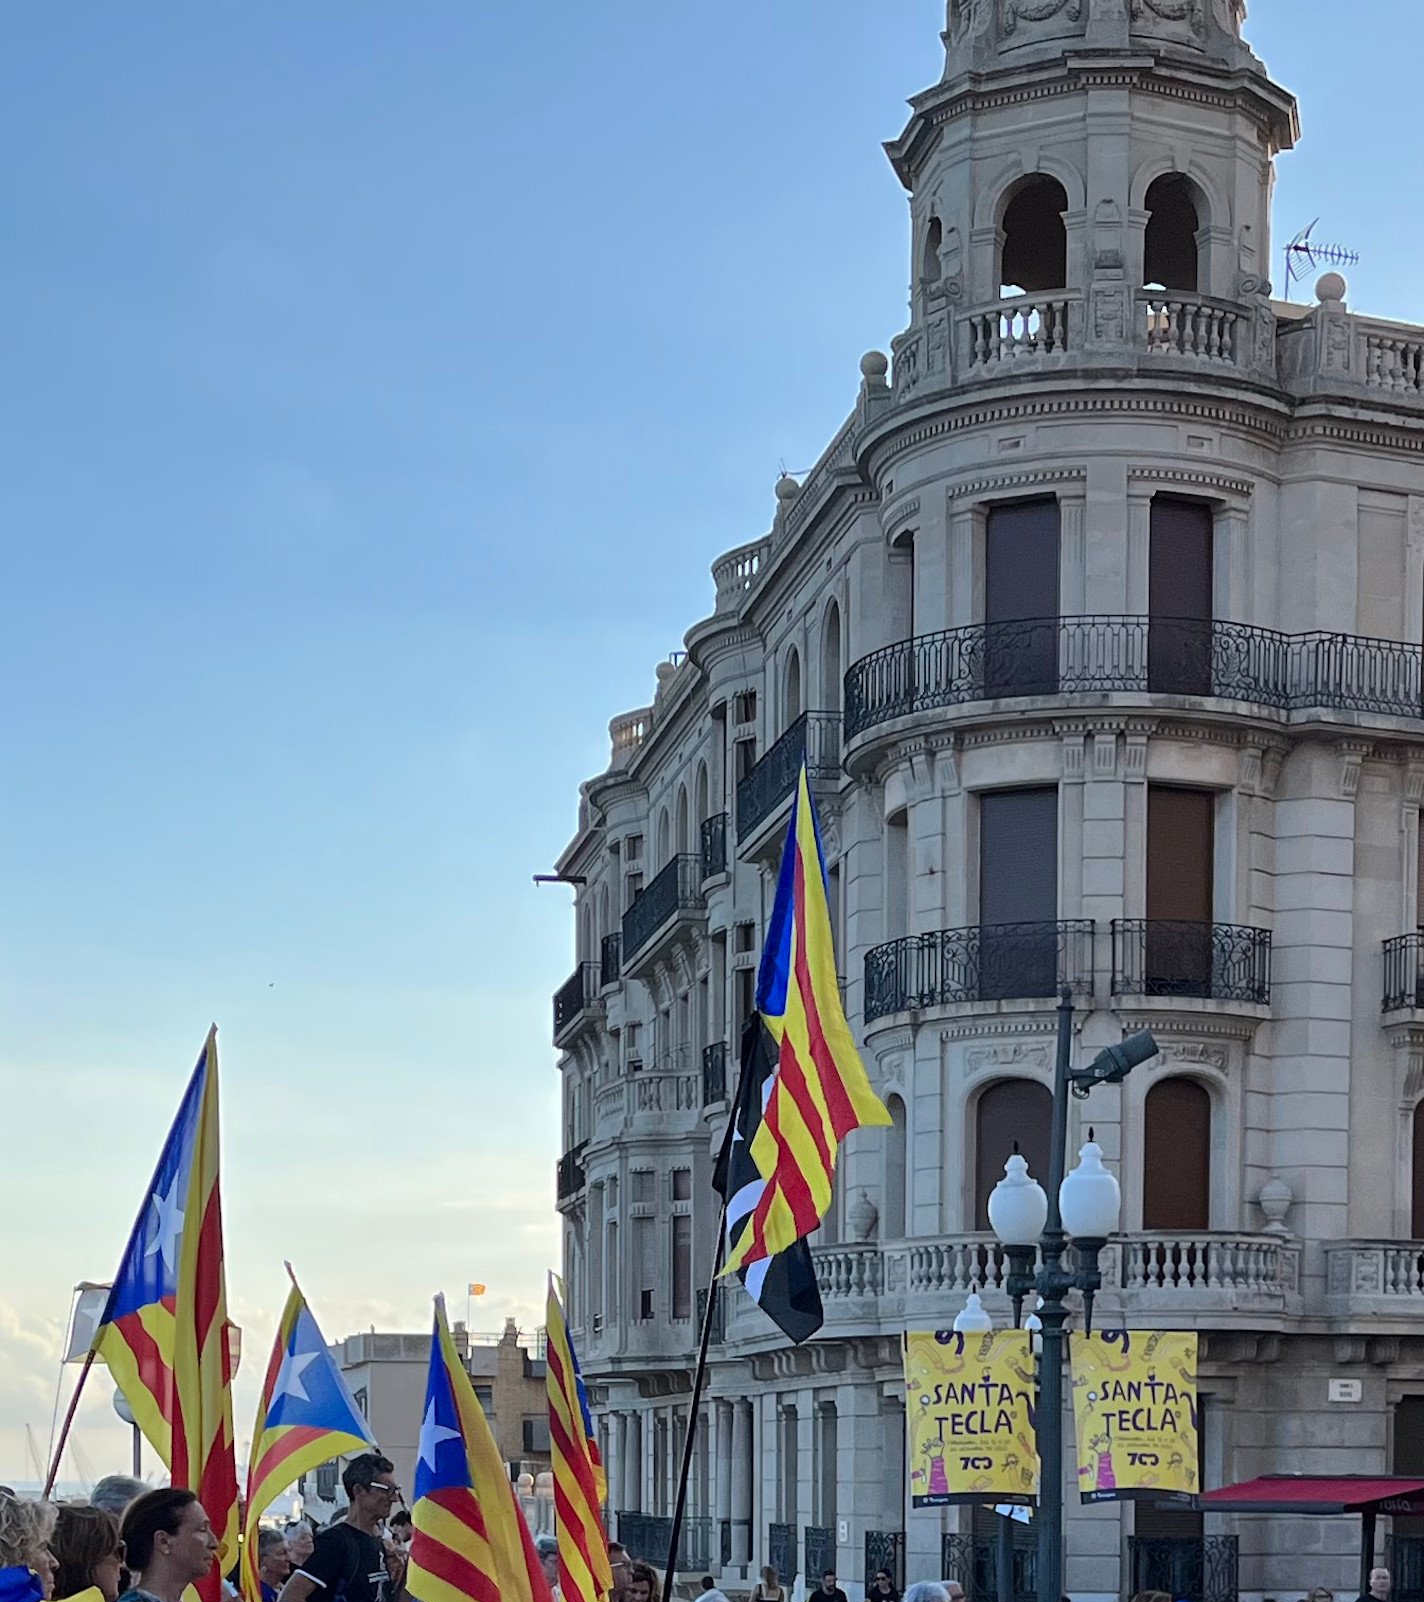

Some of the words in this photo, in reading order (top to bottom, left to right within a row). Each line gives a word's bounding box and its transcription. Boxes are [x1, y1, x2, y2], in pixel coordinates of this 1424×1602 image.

[932, 1382, 1014, 1407] SANTA
[1099, 1379, 1179, 1406] SANTA
[934, 1409, 1013, 1441] TECLA
[1101, 1407, 1178, 1437] TECLA
